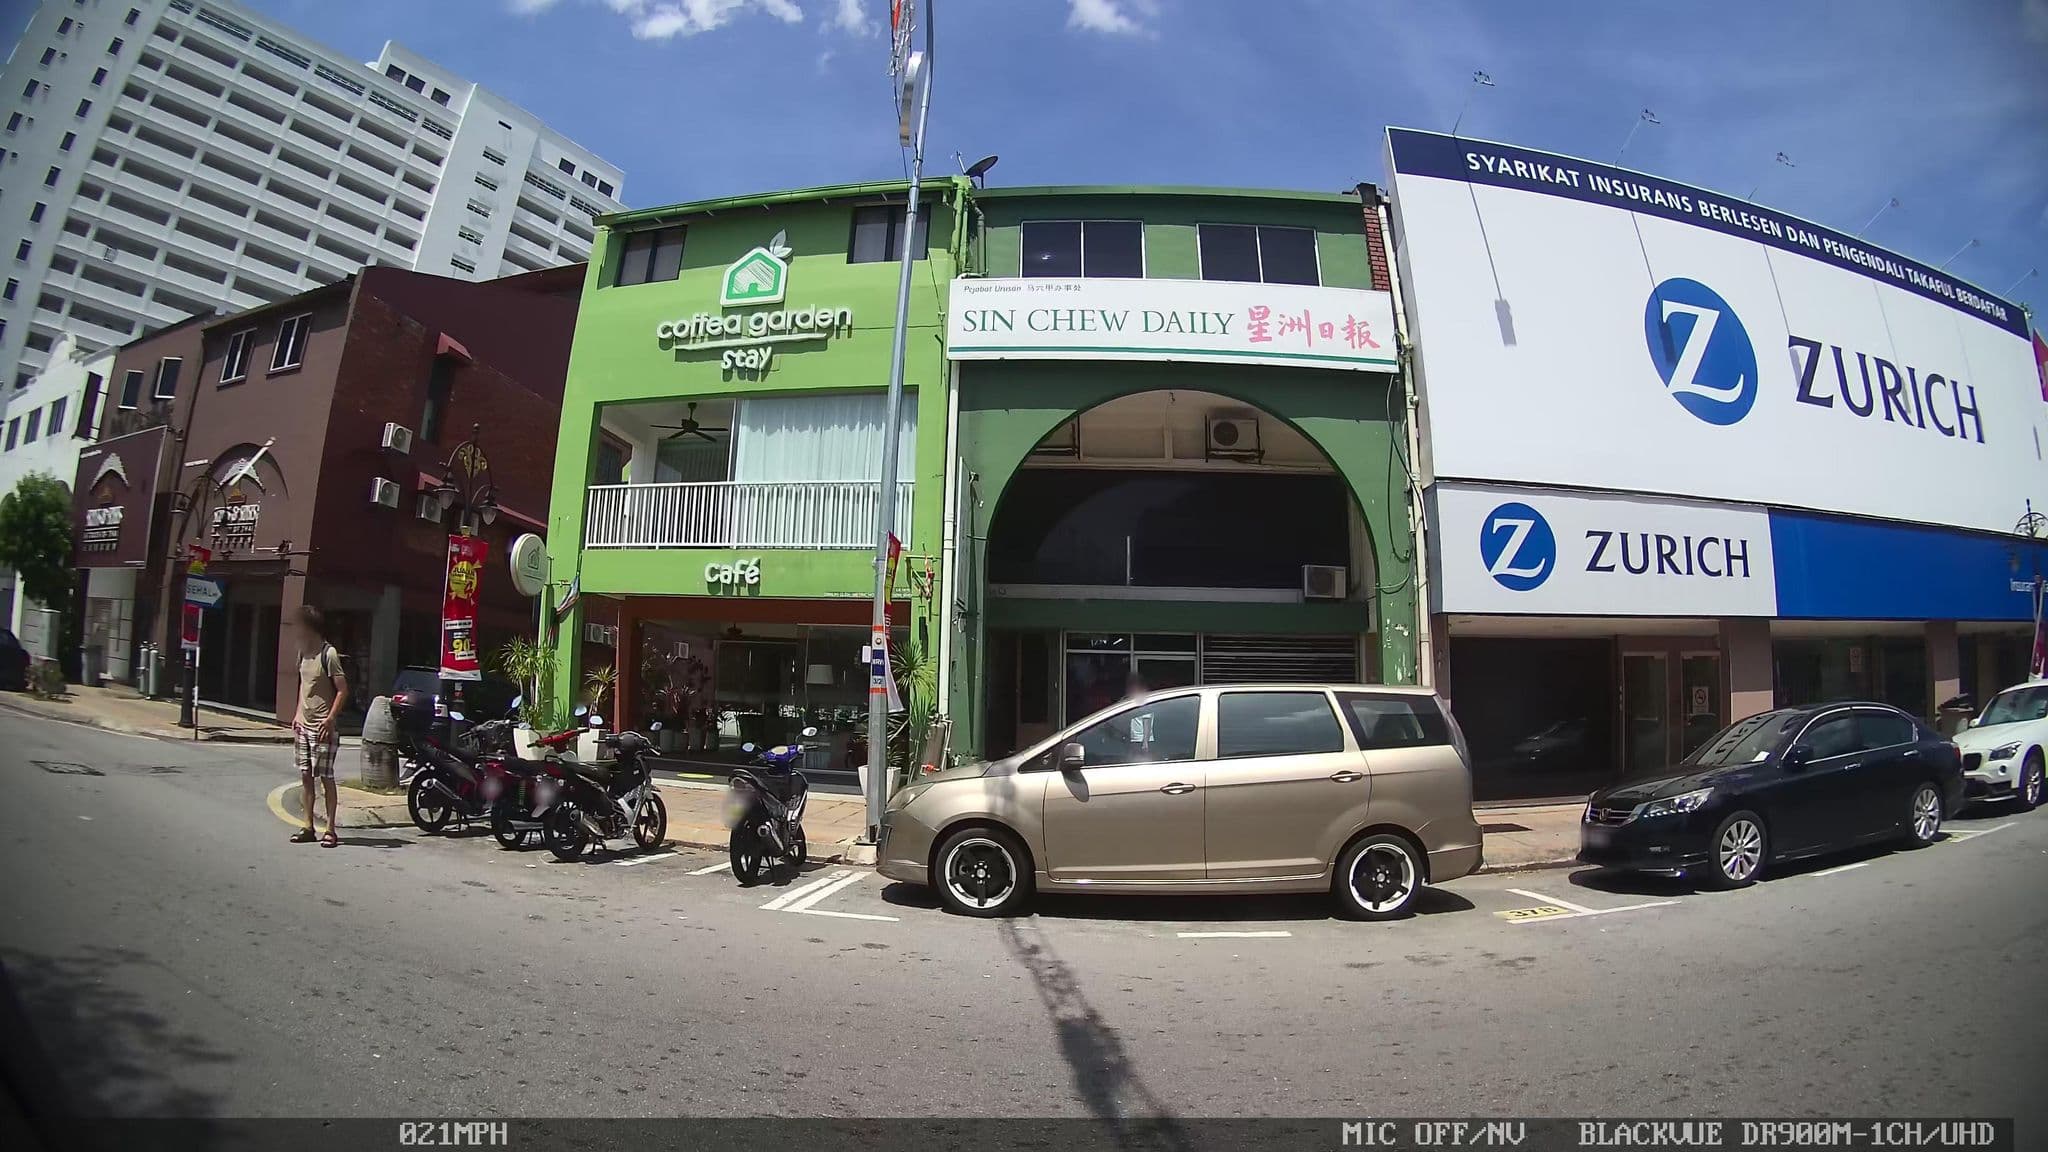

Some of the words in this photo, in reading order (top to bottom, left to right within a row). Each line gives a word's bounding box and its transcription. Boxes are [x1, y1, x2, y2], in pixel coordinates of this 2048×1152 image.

[1465, 152, 1580, 188] SYARIKAT
[1588, 173, 1693, 213] INSURANS
[1697, 199, 1783, 239] BERLESEN
[1785, 225, 1821, 251] DAN
[1822, 237, 1906, 281] PENGENDALI
[1904, 267, 1956, 300] TAKAFUL
[1954, 287, 2008, 322] BERDAFTAR
[994, 285, 1022, 293] Urusan
[656, 313, 742, 340] coffea
[749, 304, 853, 338] garden
[962, 309, 1017, 333] SIN
[1027, 308, 1131, 333] CHEW
[1142, 310, 1236, 336] DAILY
[1246, 305, 1381, 350] 星洲日報
[721, 346, 772, 370] stay
[1787, 334, 1985, 445] ZURICH
[1584, 529, 1751, 579] ZURICH
